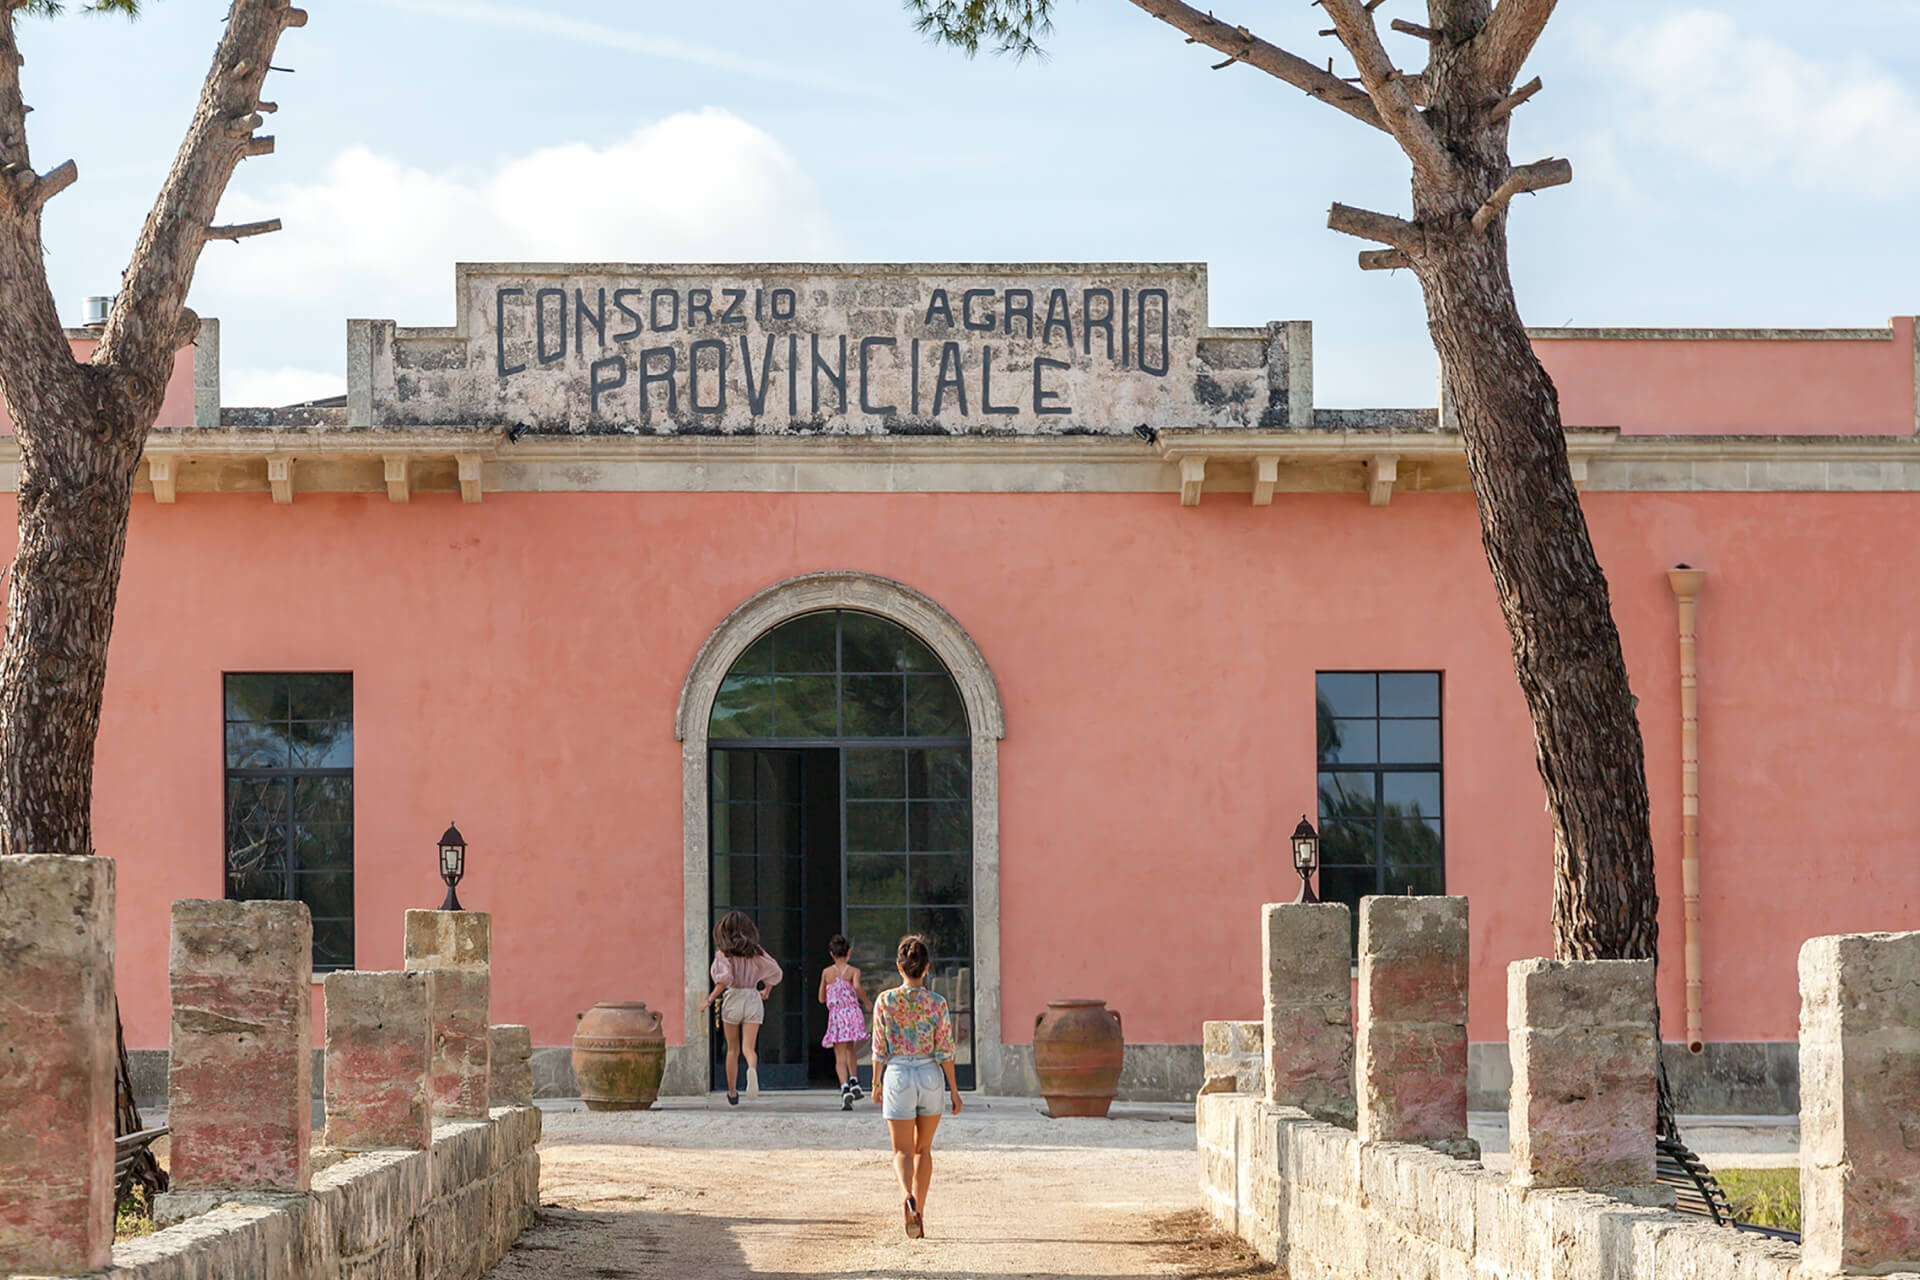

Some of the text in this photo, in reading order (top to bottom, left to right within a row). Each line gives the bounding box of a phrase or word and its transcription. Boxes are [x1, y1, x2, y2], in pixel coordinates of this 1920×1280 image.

[498, 288, 1169, 377] CONSORZIO AGRARIO
[590, 334, 1073, 416] PROVINCIALE
